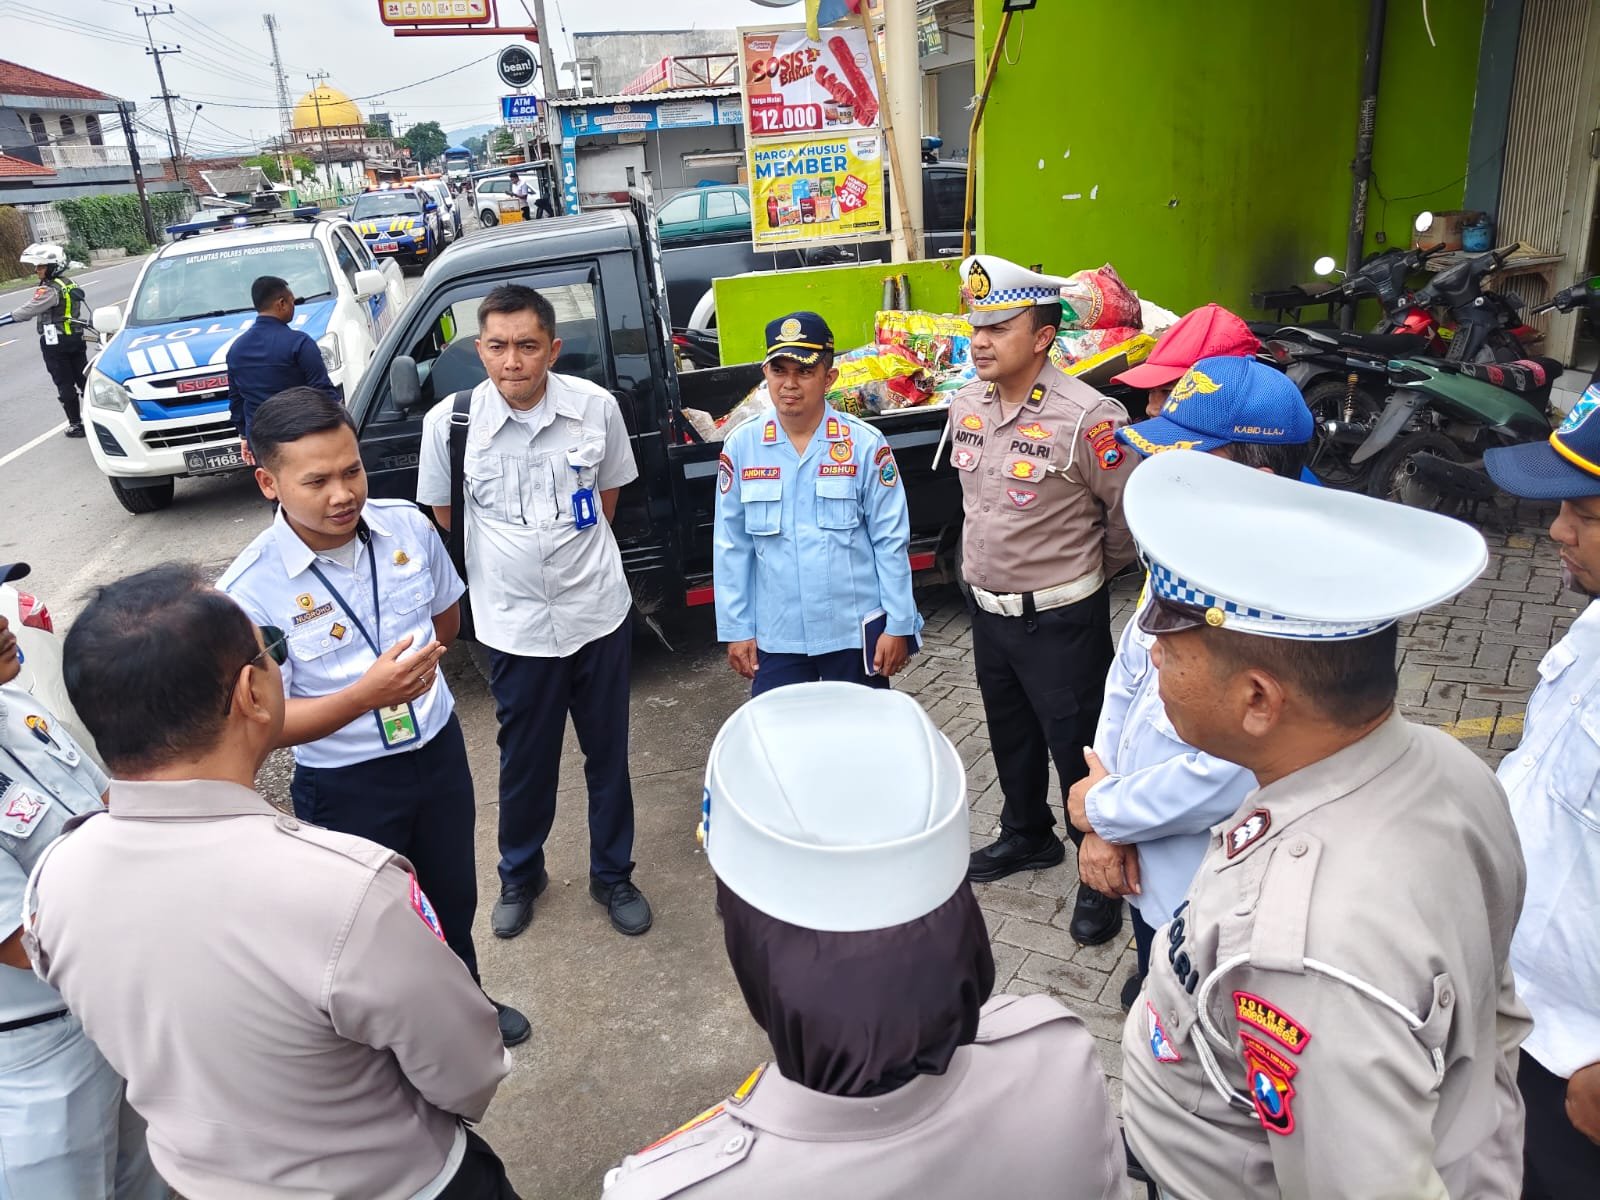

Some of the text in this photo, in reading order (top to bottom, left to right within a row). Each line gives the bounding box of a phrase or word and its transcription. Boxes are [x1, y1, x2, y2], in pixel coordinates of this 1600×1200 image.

[502, 59, 532, 73] bean!
[752, 51, 804, 83] SOSIS
[780, 64, 814, 86] BAKAR
[514, 98, 531, 107] ATM
[520, 106, 536, 114] BCA
[760, 106, 817, 130] 12.000
[754, 144, 847, 161] HARGA KHUSUS
[756, 155, 848, 180] MEMBER
[839, 189, 862, 207] 30%
[186, 252, 219, 265] SATLANTAS
[219, 249, 243, 260] POLRES
[128, 314, 308, 350] POLII
[178, 375, 229, 393] ISUZU
[955, 430, 984, 447] ADITYA
[1233, 425, 1285, 435] KABID LLAJ
[1010, 440, 1050, 459] POLRI
[207, 453, 242, 469] 1168-
[744, 468, 766, 478] ANDIK
[1240, 997, 1299, 1037] POLRES
